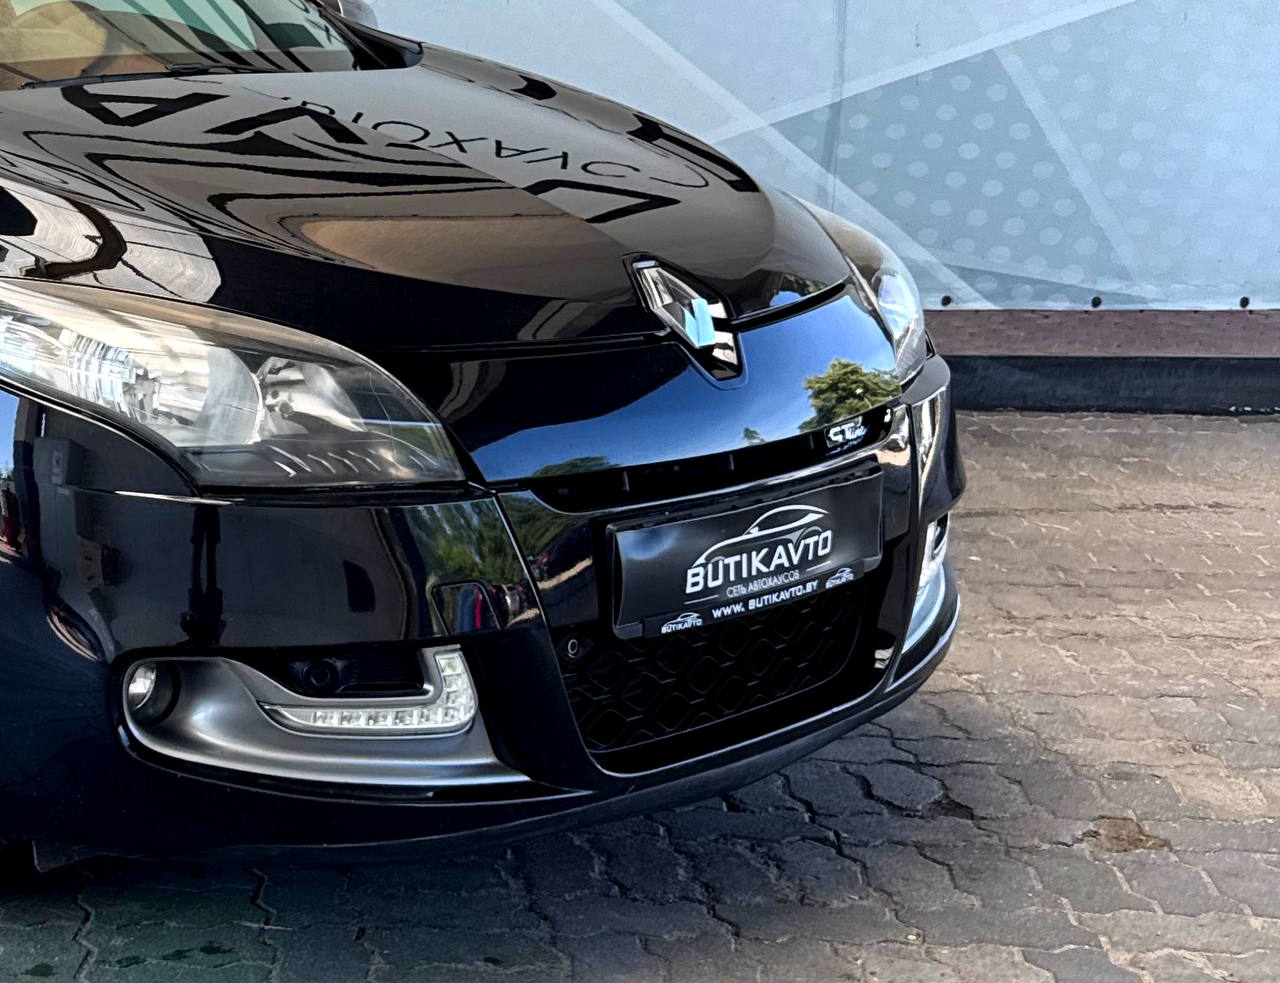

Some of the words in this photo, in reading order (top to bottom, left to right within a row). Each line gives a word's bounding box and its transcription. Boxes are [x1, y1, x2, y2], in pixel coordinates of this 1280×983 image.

[684, 529, 833, 594] BUTIKAVTO
[726, 584, 747, 598] СЕТЬ
[748, 579, 819, 611] BUTIKAVTO.BY
